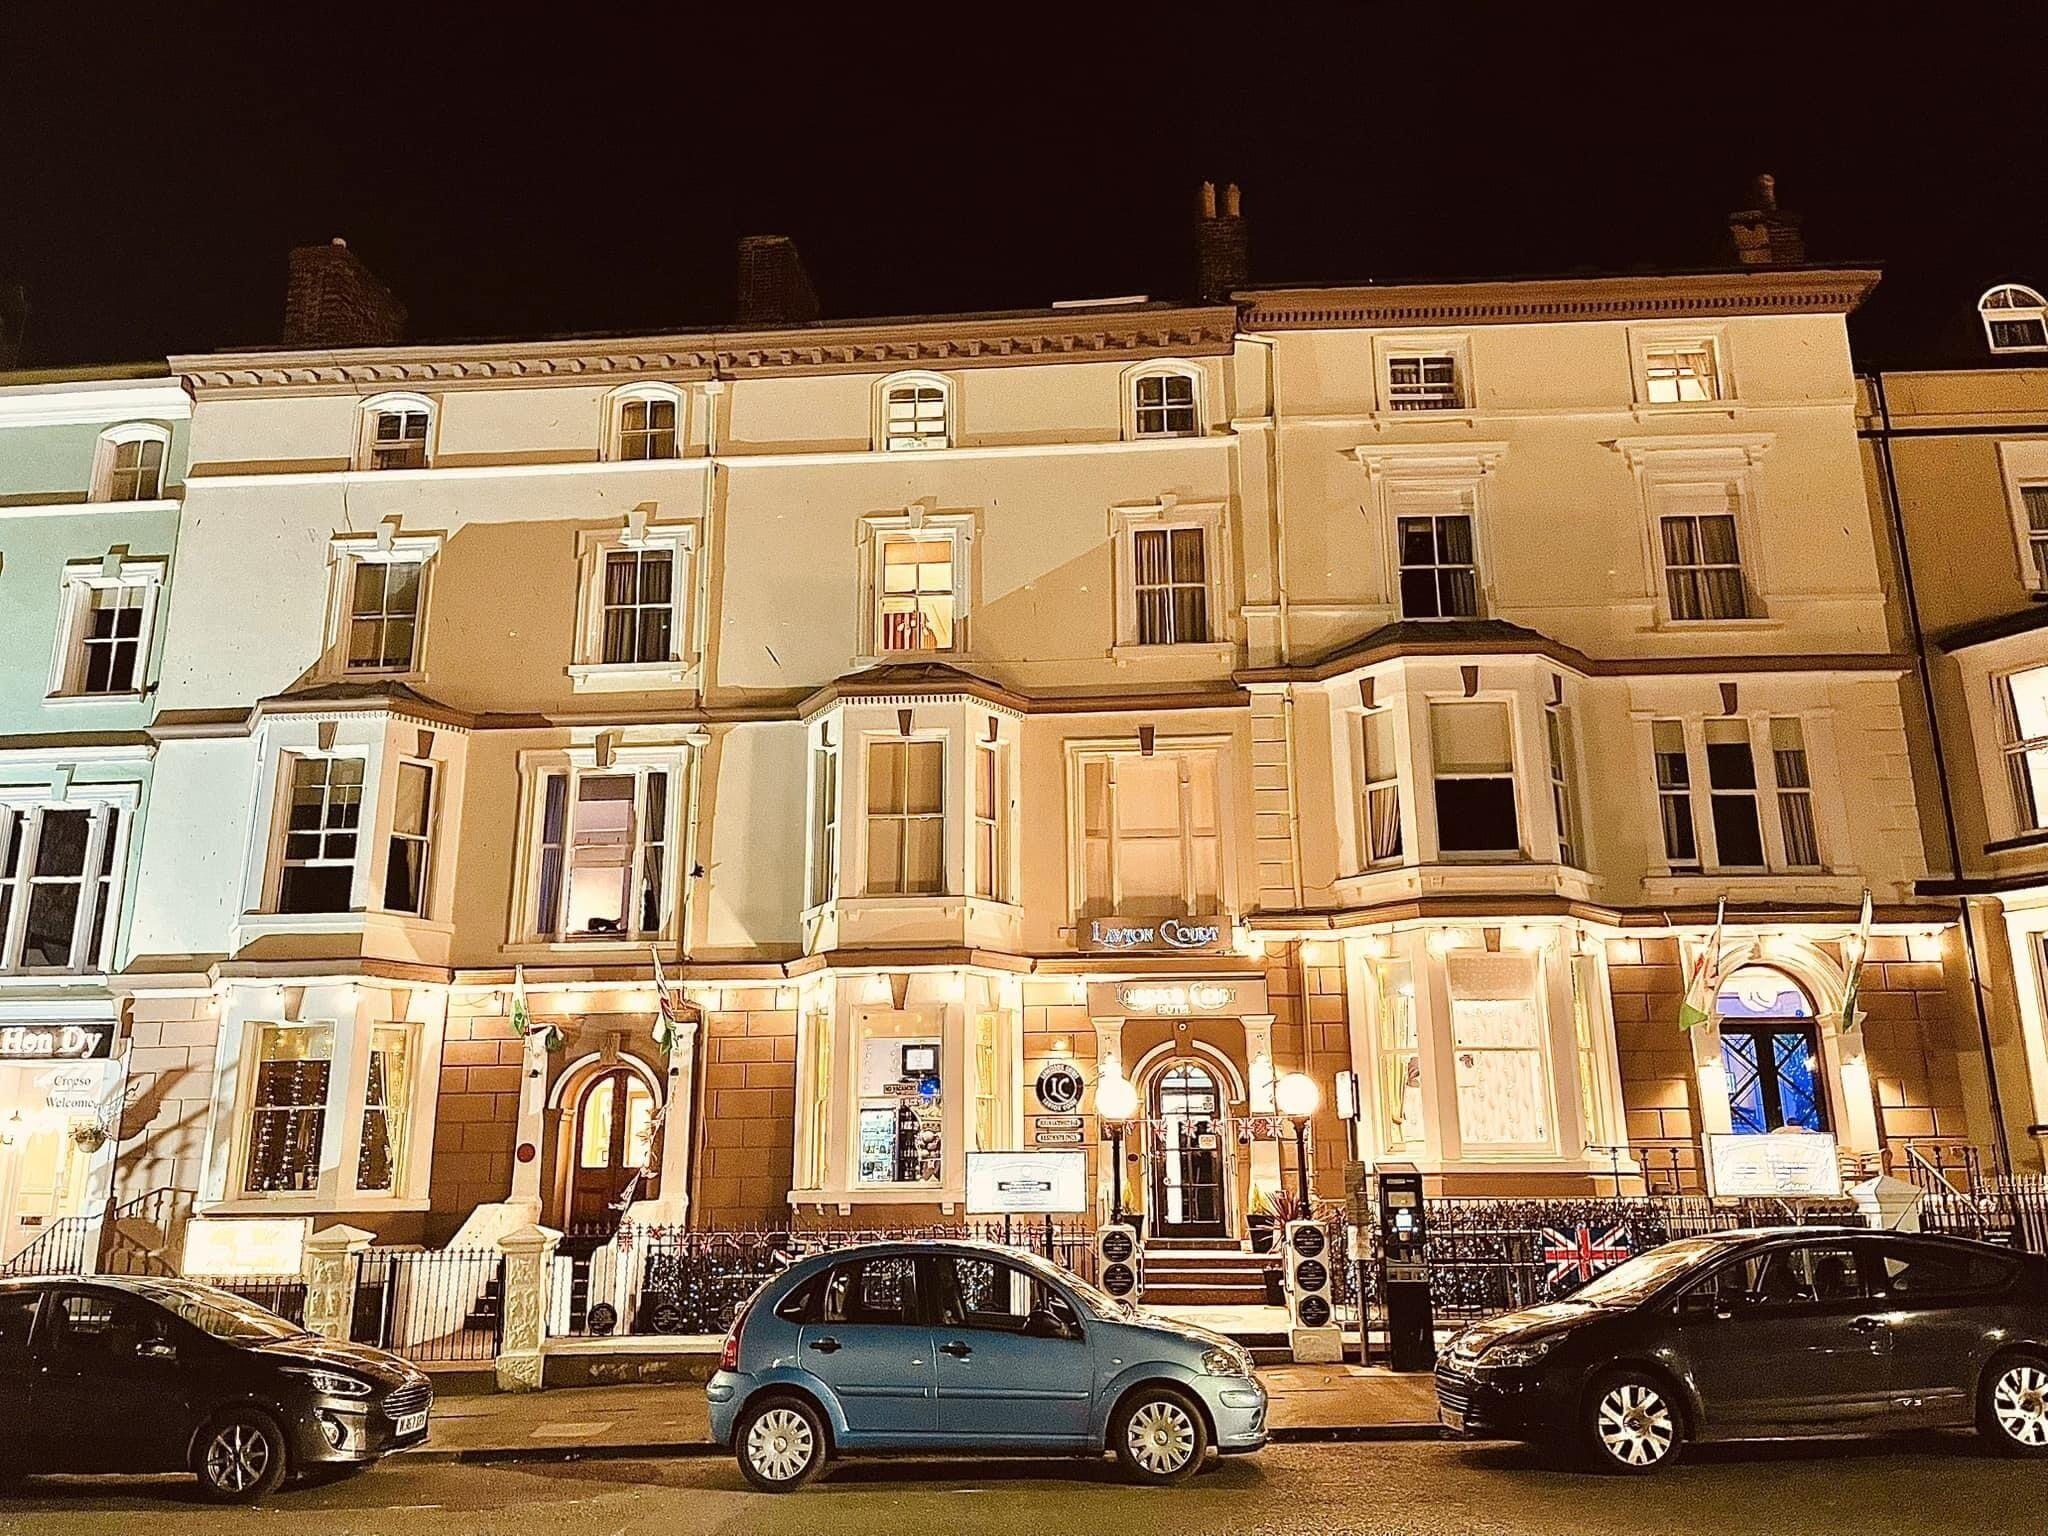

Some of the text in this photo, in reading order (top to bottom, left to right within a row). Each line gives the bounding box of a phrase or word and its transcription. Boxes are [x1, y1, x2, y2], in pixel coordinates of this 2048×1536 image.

[1160, 919, 1219, 947] COURT
[0, 1026, 102, 1059] Hen Dy
[46, 1096, 97, 1109] Welcome
